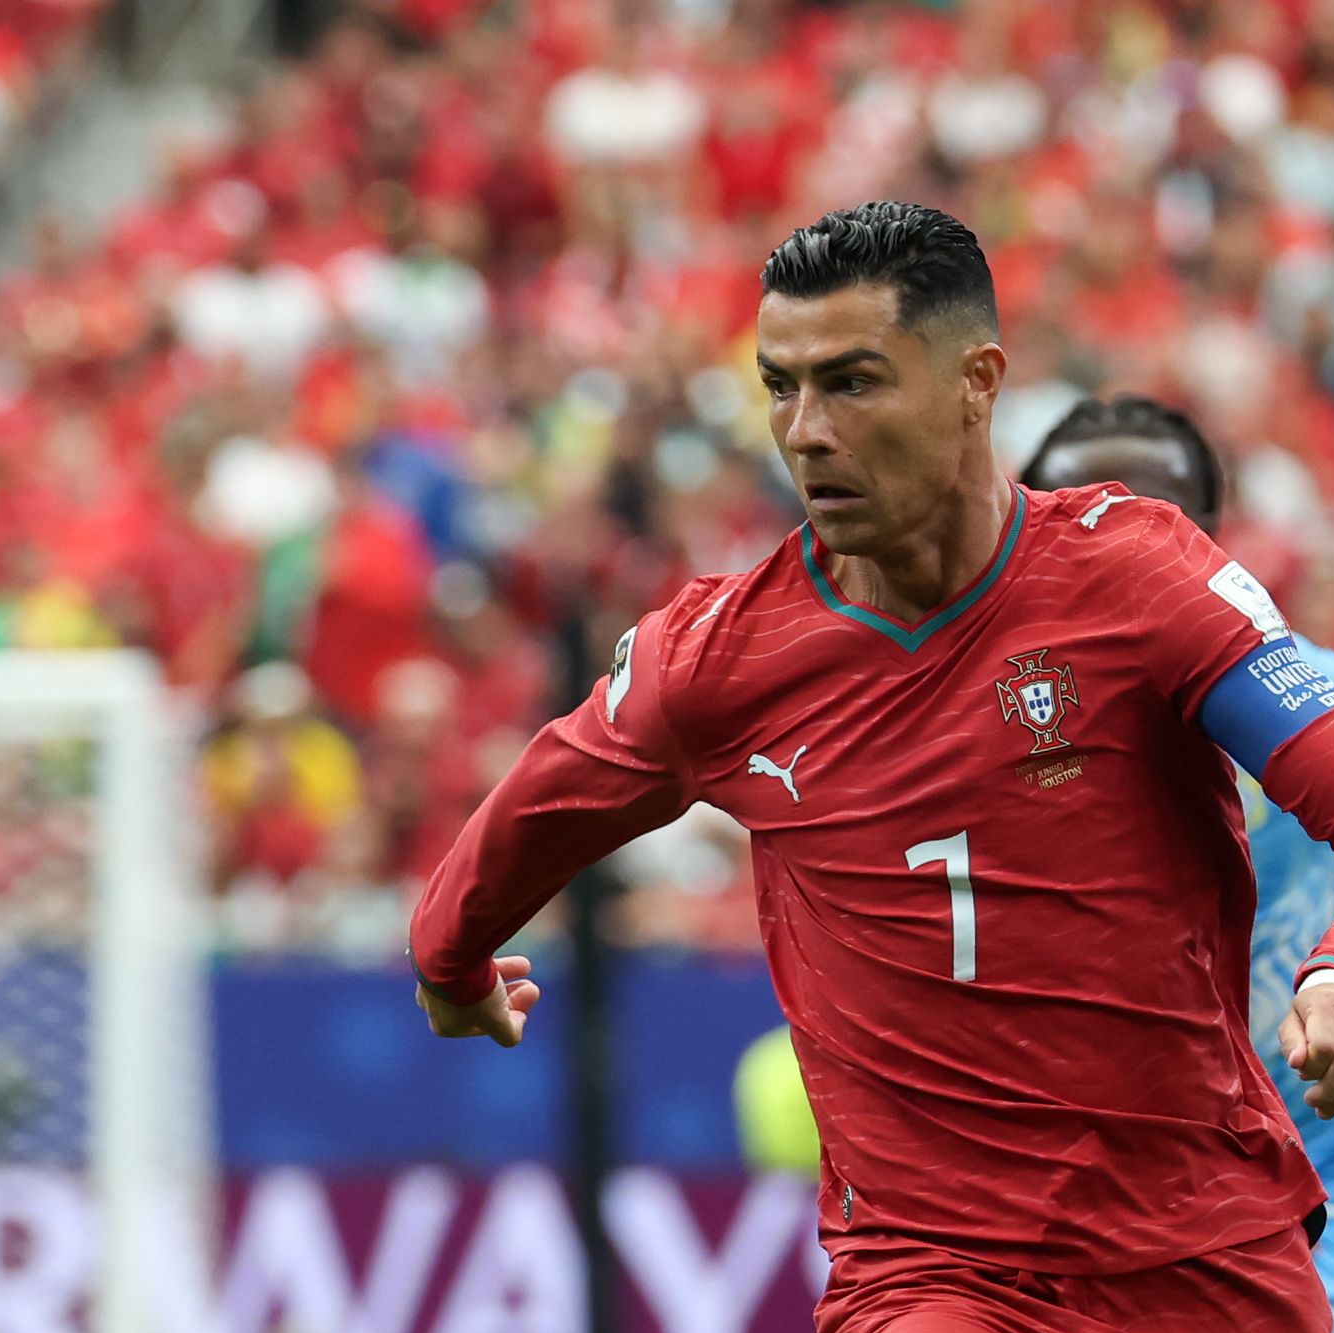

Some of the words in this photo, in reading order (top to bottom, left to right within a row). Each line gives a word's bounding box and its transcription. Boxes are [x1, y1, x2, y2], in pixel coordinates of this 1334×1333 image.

[1279, 692, 1313, 712] the
[1024, 773, 1033, 785] 17
[1036, 762, 1064, 780] JUNHO
[1038, 765, 1083, 791] HOUSTON
[904, 830, 976, 982] 7
